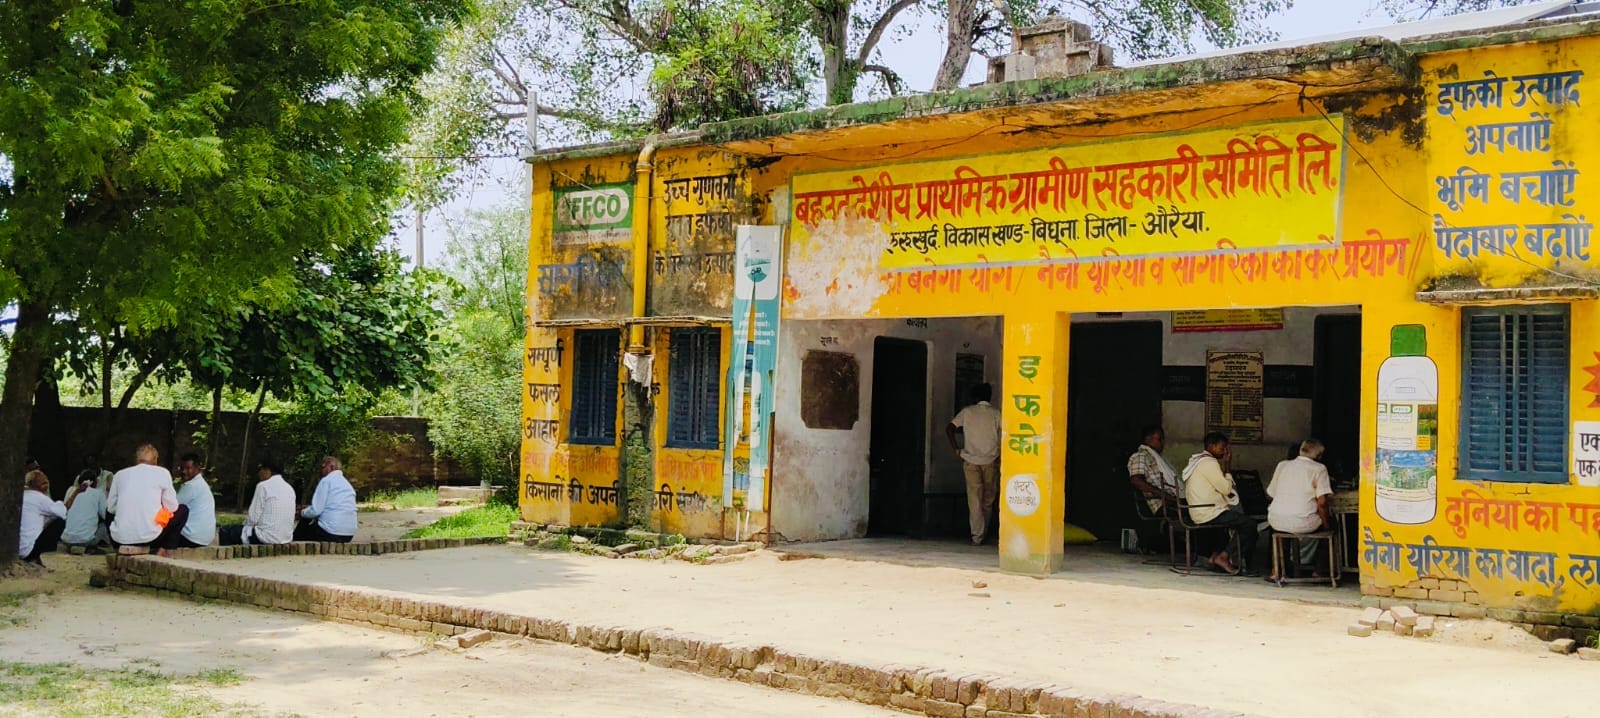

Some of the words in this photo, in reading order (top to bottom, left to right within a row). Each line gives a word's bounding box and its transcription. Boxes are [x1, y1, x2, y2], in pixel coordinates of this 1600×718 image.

[1437, 70, 1508, 121] इफको
[1510, 70, 1584, 108] उत्पाद
[663, 178, 691, 205] उच्च
[914, 165, 1007, 221] प्राथमिक
[1008, 156, 1091, 215] ग्रामीण
[1092, 144, 1202, 211] सहकारी
[1203, 135, 1293, 199] समिति
[1436, 166, 1492, 212] भूमि
[944, 223, 992, 248] विकास
[1342, 228, 1411, 279] प्रयोग
[528, 383, 561, 404] फसल
[524, 473, 566, 503] किसानों
[1445, 489, 1521, 539] दुनिया
[1523, 500, 1563, 533] का
[1364, 526, 1403, 572] नैनो
[1406, 535, 1471, 579] यूरिया
